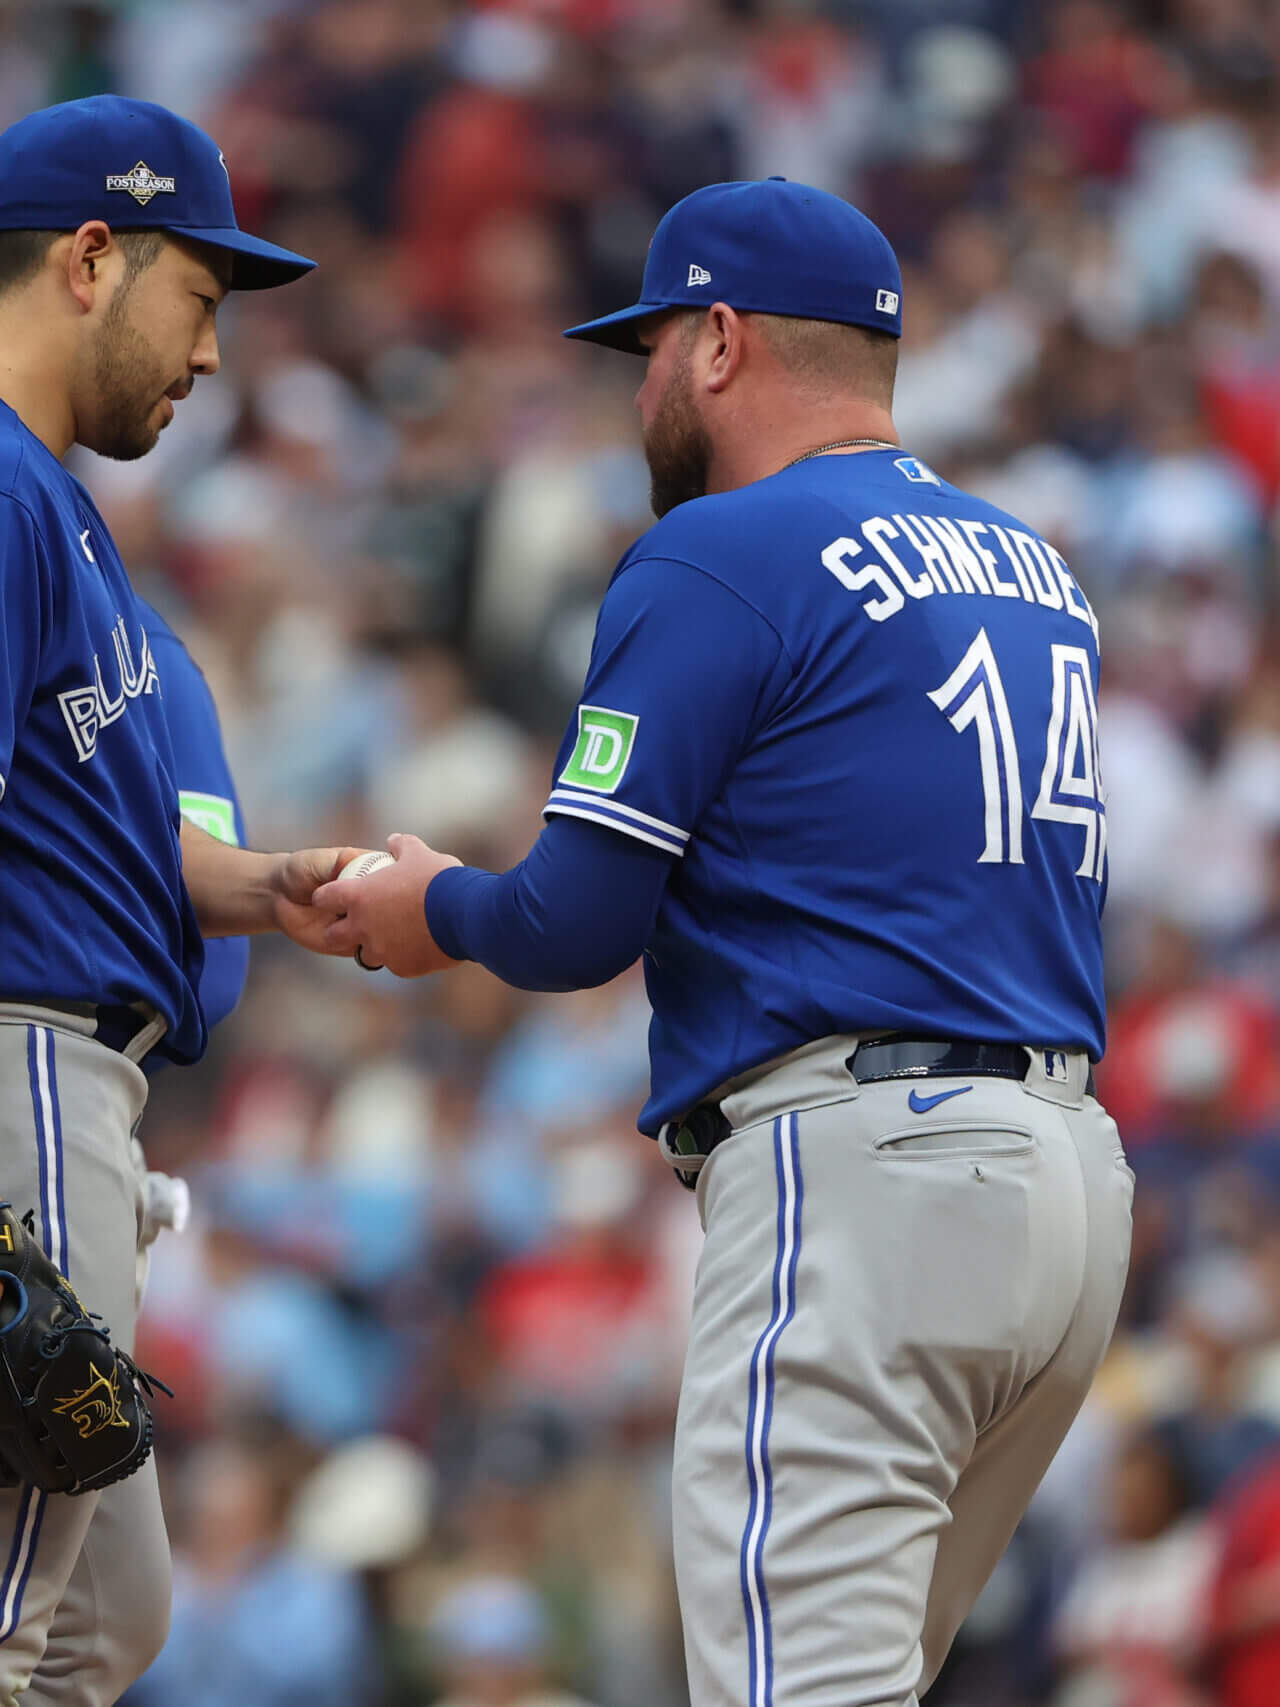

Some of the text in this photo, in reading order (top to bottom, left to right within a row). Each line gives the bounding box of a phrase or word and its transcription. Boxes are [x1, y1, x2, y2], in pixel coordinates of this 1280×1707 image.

[106, 177, 175, 191] POSTSEASON
[821, 514, 1100, 656] SCHNEIDE
[580, 723, 623, 774] TD
[926, 626, 1107, 886] 14
